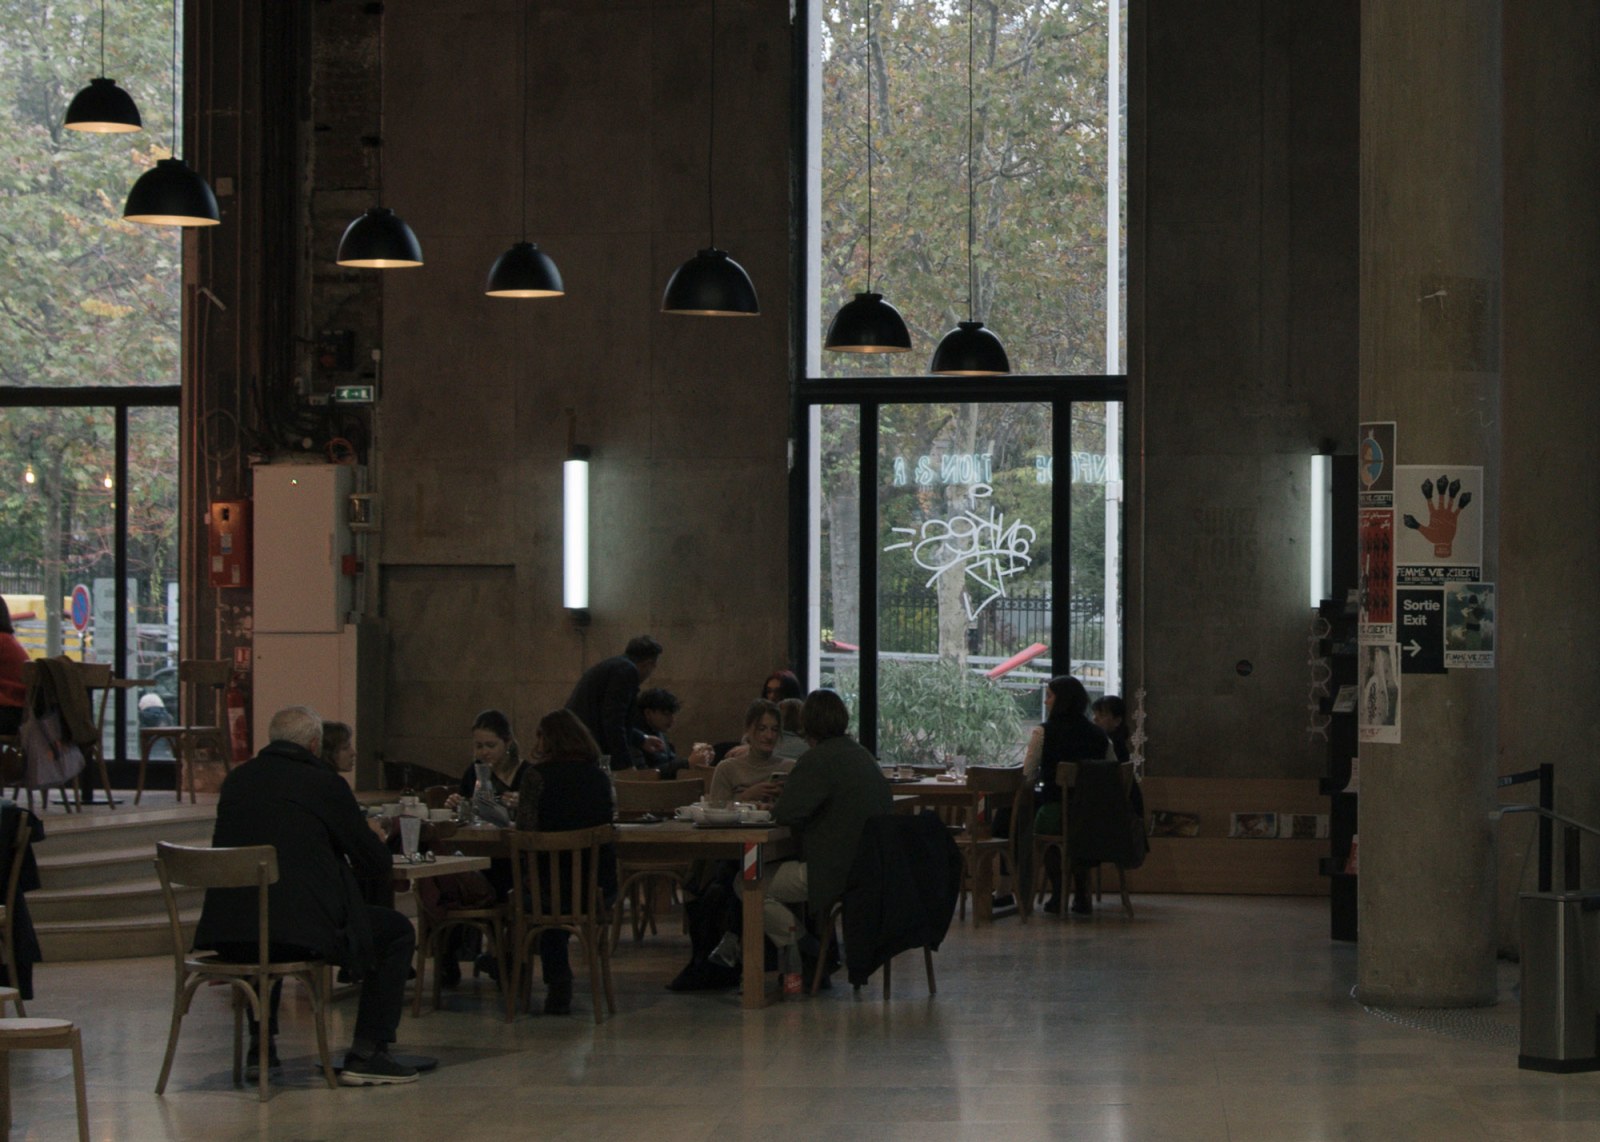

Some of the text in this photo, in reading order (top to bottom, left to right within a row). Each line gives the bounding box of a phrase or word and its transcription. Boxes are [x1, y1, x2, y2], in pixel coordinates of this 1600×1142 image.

[1397, 567, 1426, 577] FEMME
[1428, 567, 1445, 577] VIE
[1403, 599, 1441, 611] Sortie
[1403, 614, 1428, 626] Exit
